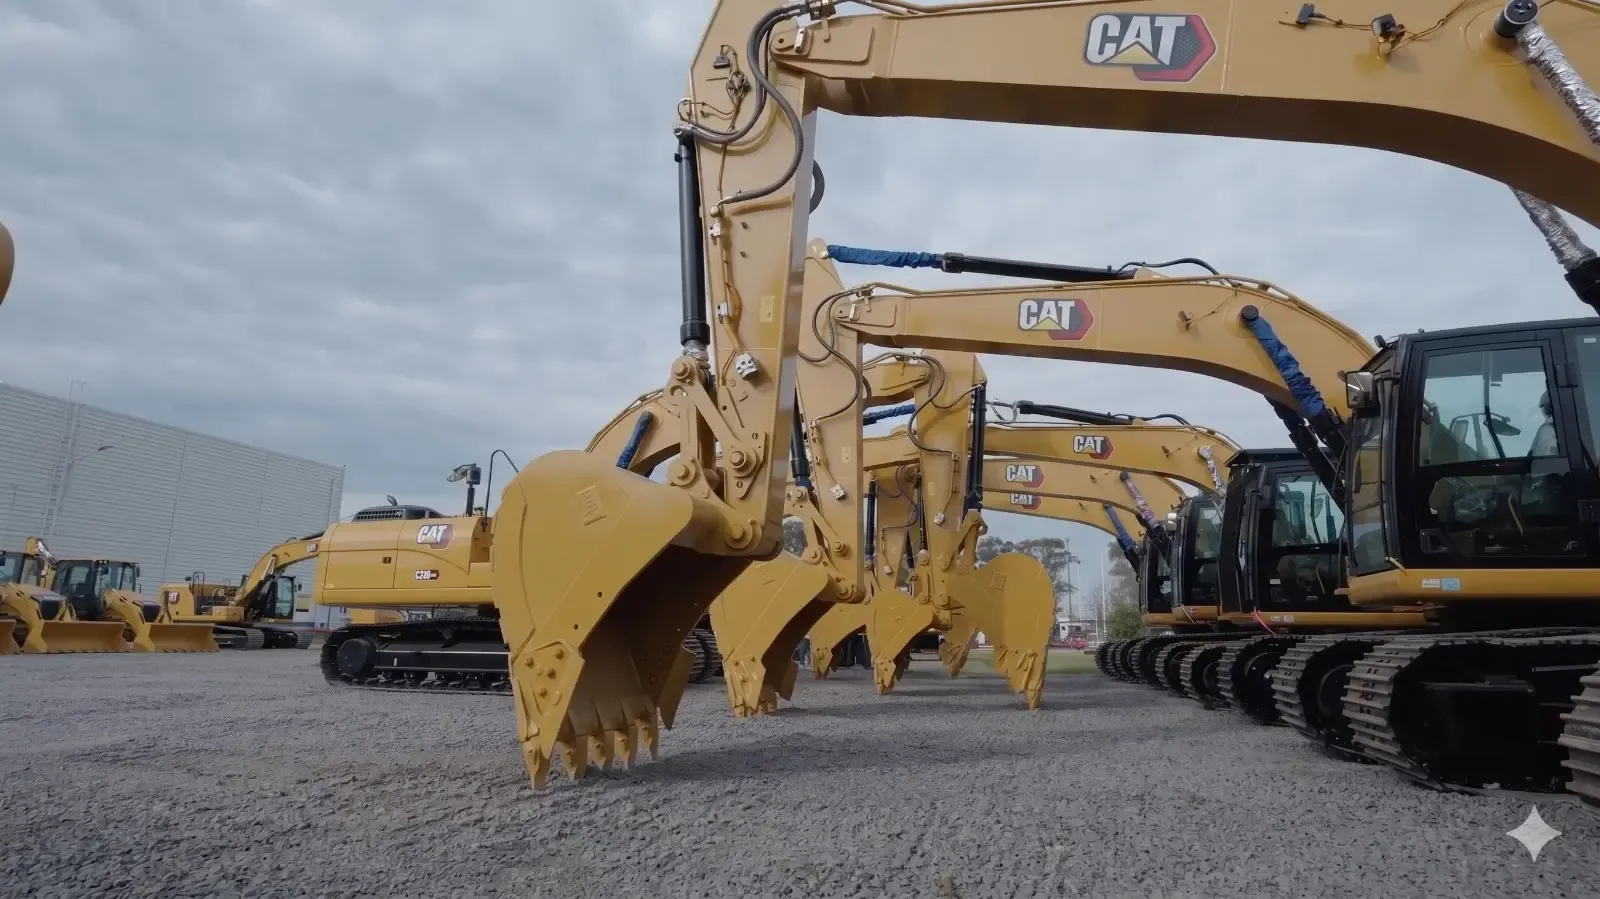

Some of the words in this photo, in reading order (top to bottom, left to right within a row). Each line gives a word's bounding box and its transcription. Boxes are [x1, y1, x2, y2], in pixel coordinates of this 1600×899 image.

[1086, 14, 1186, 65] CAT
[1019, 299, 1076, 330] CAT
[1074, 435, 1105, 454] CAT
[1006, 465, 1036, 482] CAT
[1010, 493, 1033, 505] CAT
[416, 525, 448, 543] CAT
